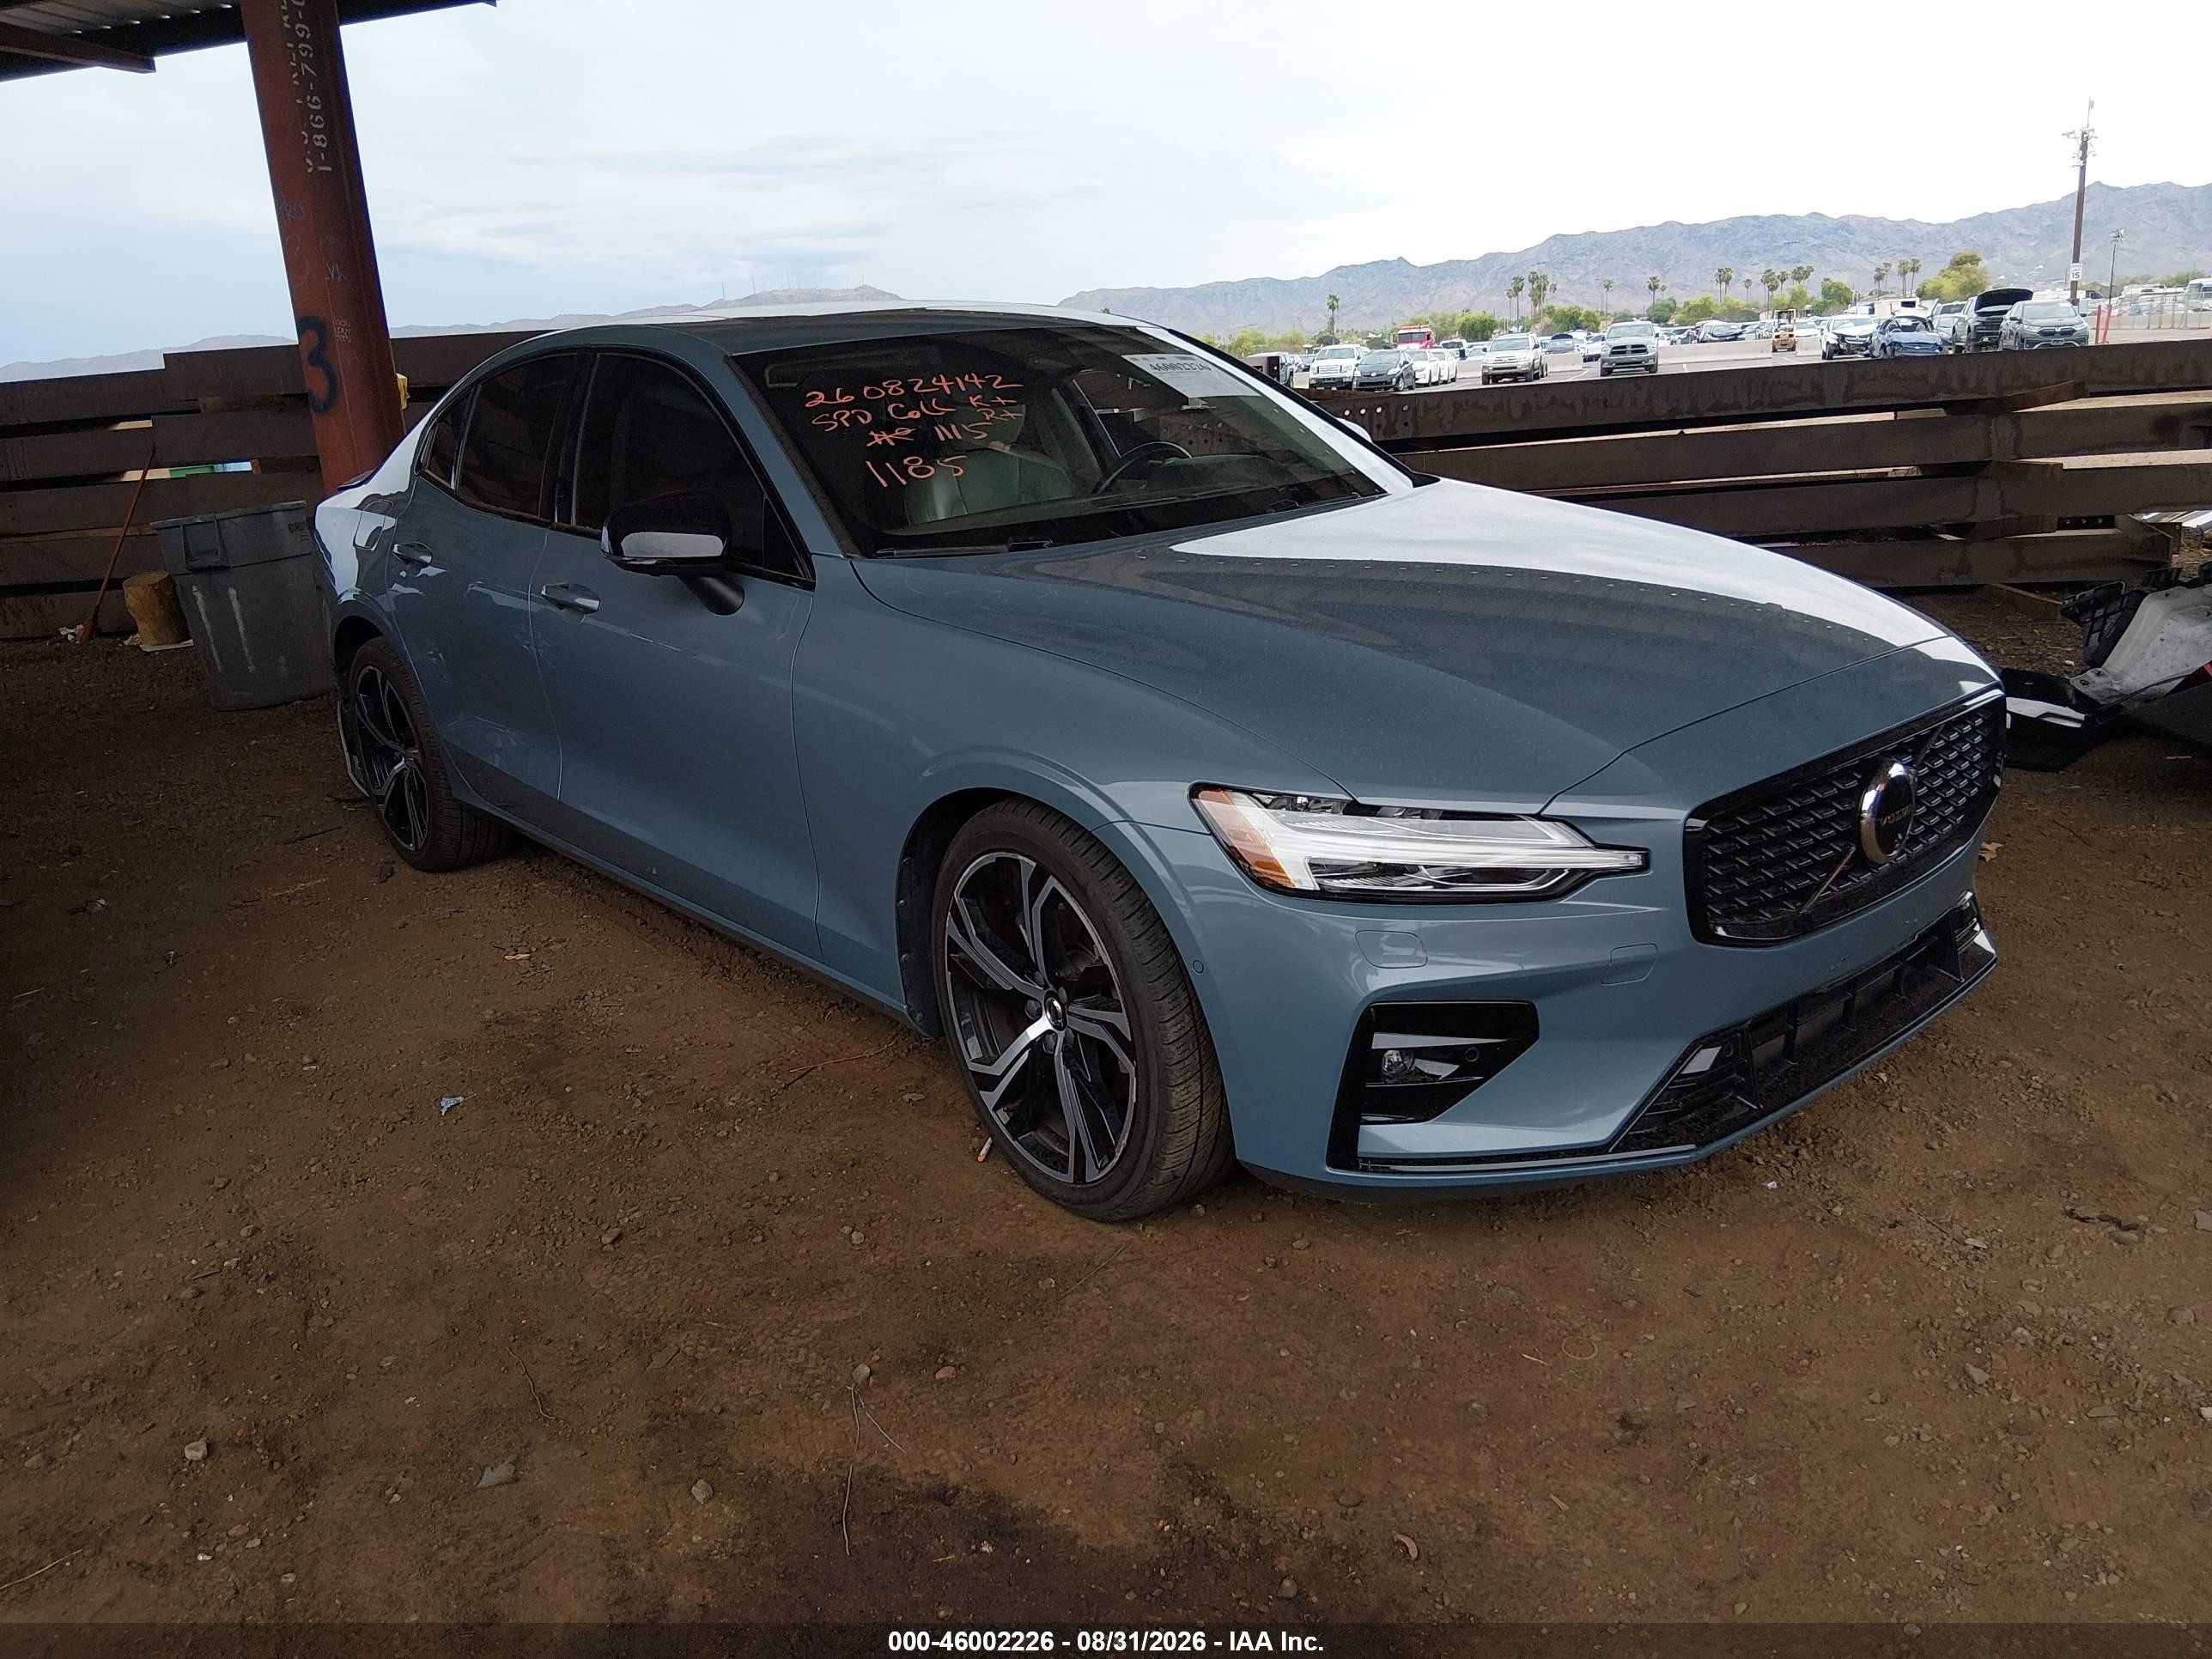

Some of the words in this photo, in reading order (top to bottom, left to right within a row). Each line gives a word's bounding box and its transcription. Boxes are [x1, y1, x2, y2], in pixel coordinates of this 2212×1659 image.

[295, 315, 337, 414] 3
[811, 409, 873, 432] SPD
[866, 455, 968, 488] 1185
